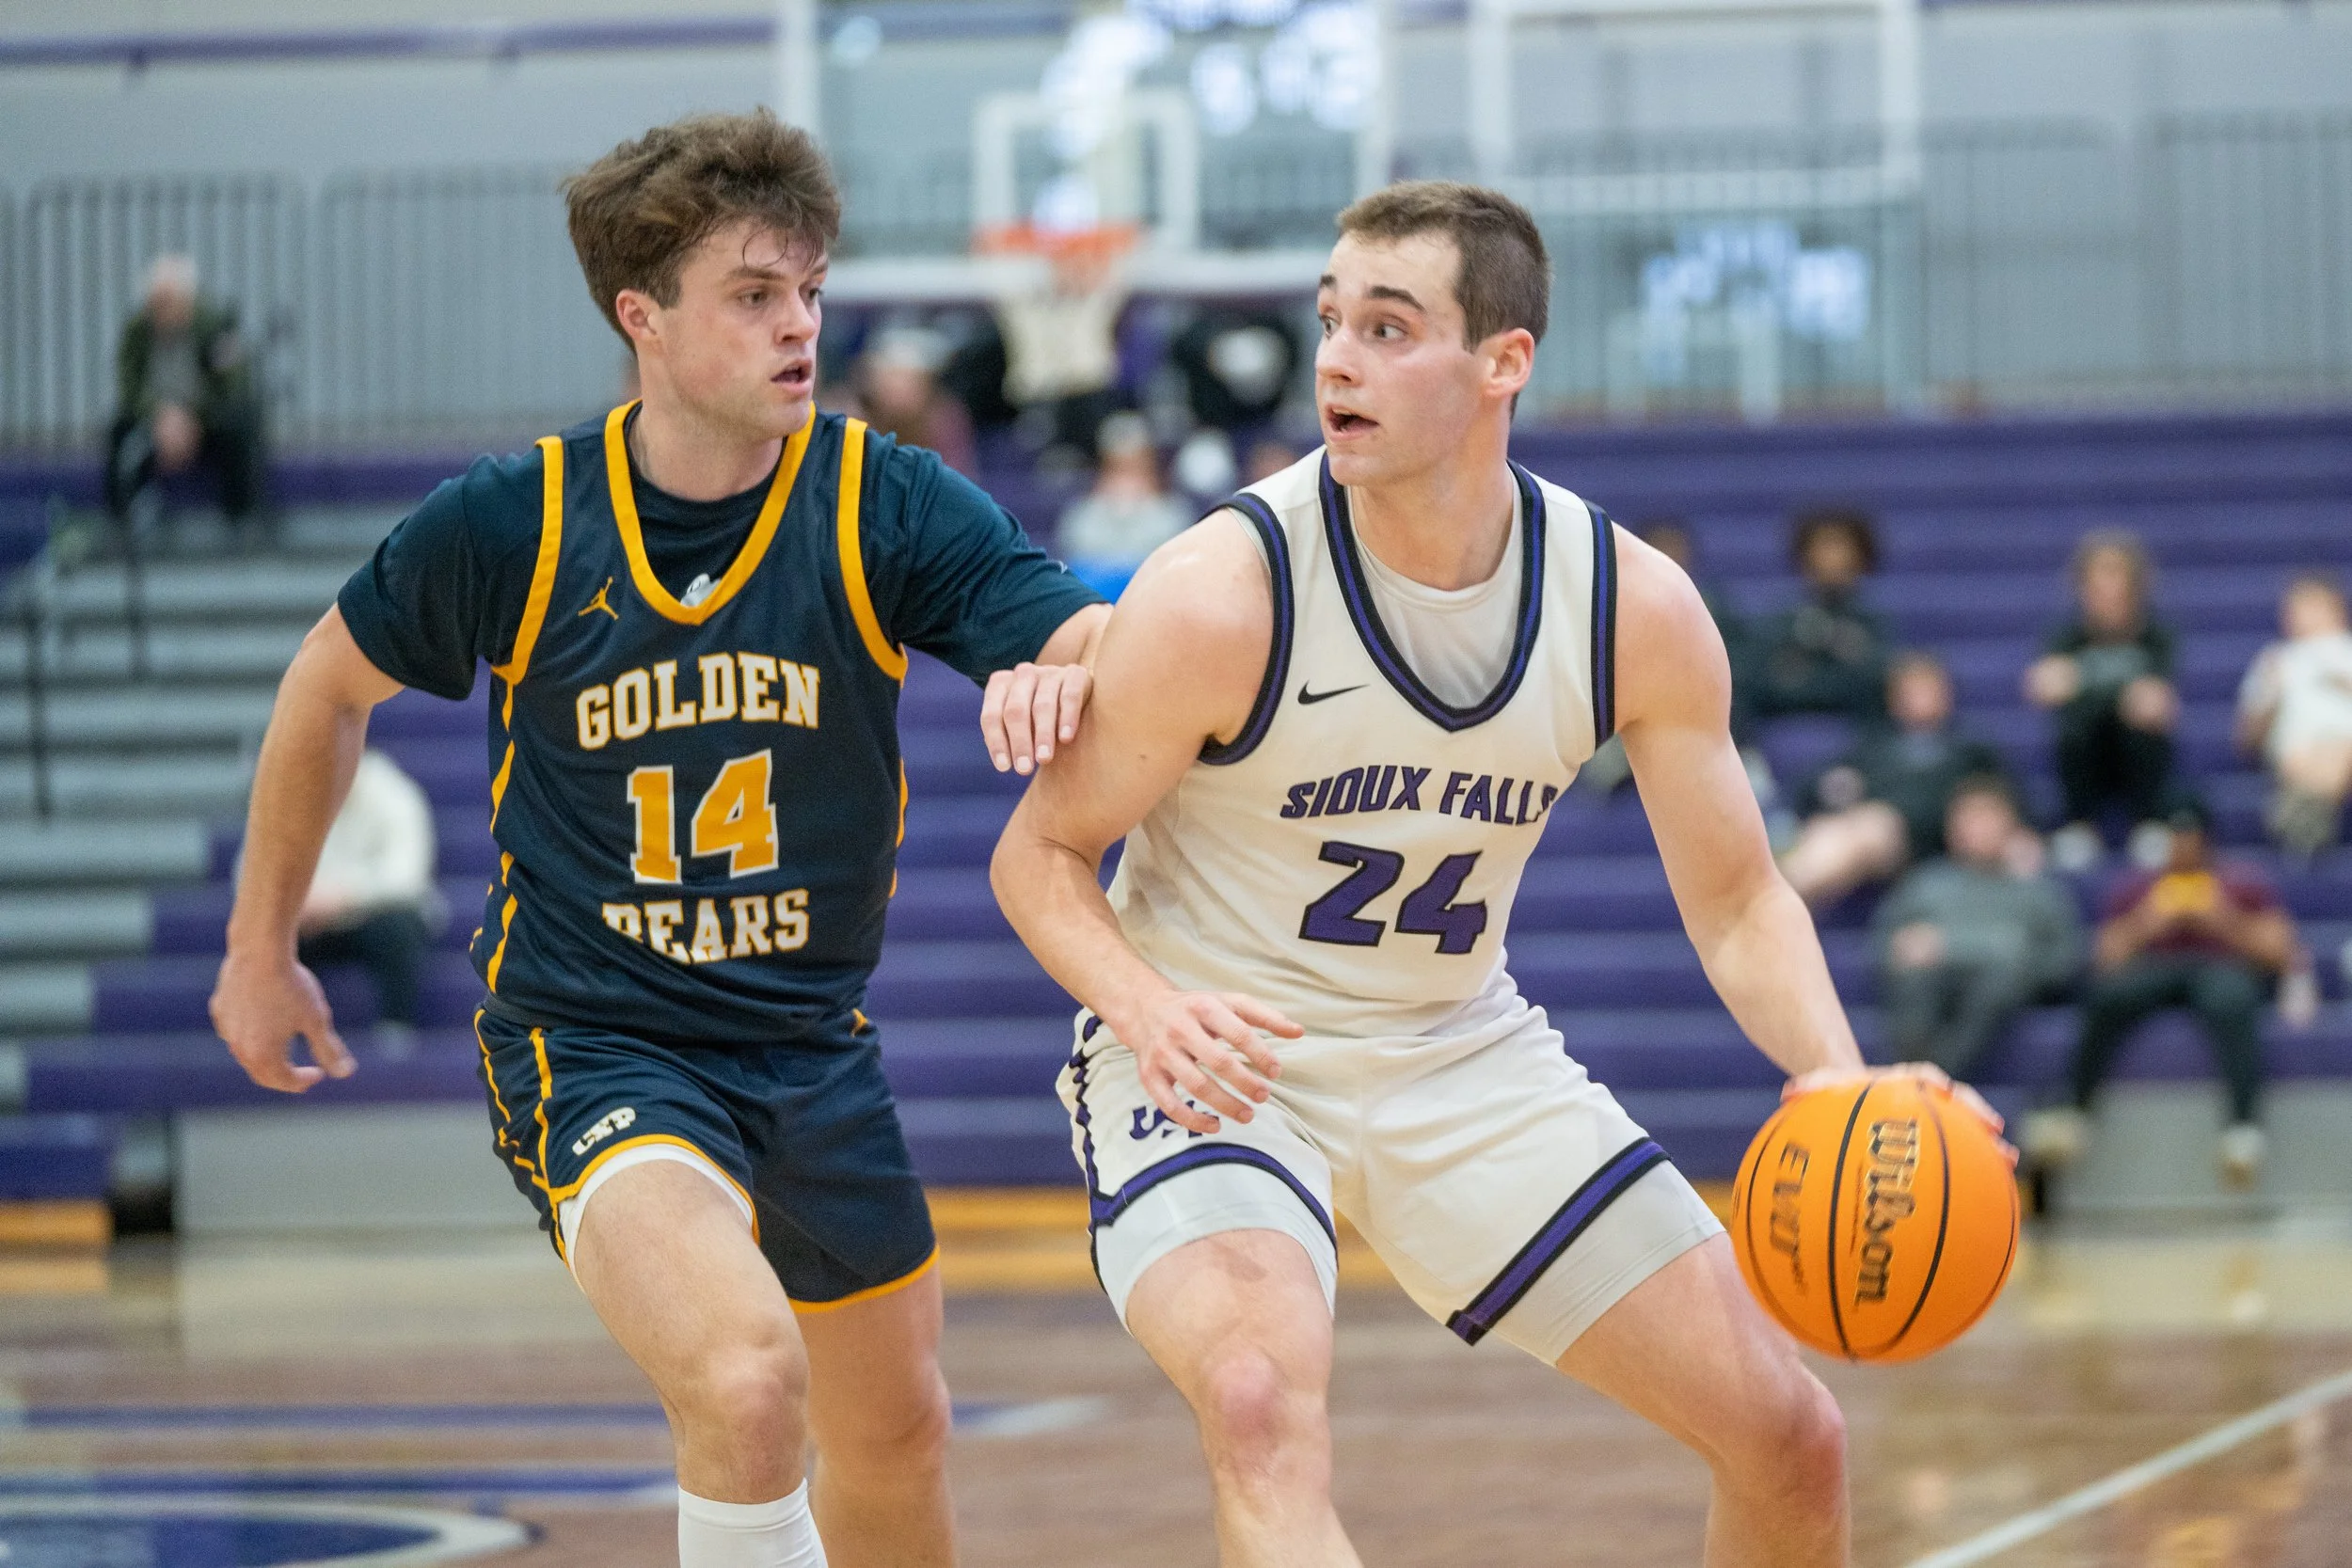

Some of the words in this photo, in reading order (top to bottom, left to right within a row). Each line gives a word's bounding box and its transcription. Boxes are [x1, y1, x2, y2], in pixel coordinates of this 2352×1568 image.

[576, 651, 820, 751] GOLDEN
[627, 749, 779, 885] 14
[1279, 765, 1432, 818] SIOUX
[602, 888, 809, 966] BEARS
[1298, 840, 1487, 955] 24
[1852, 1115, 1920, 1308] Wilson
